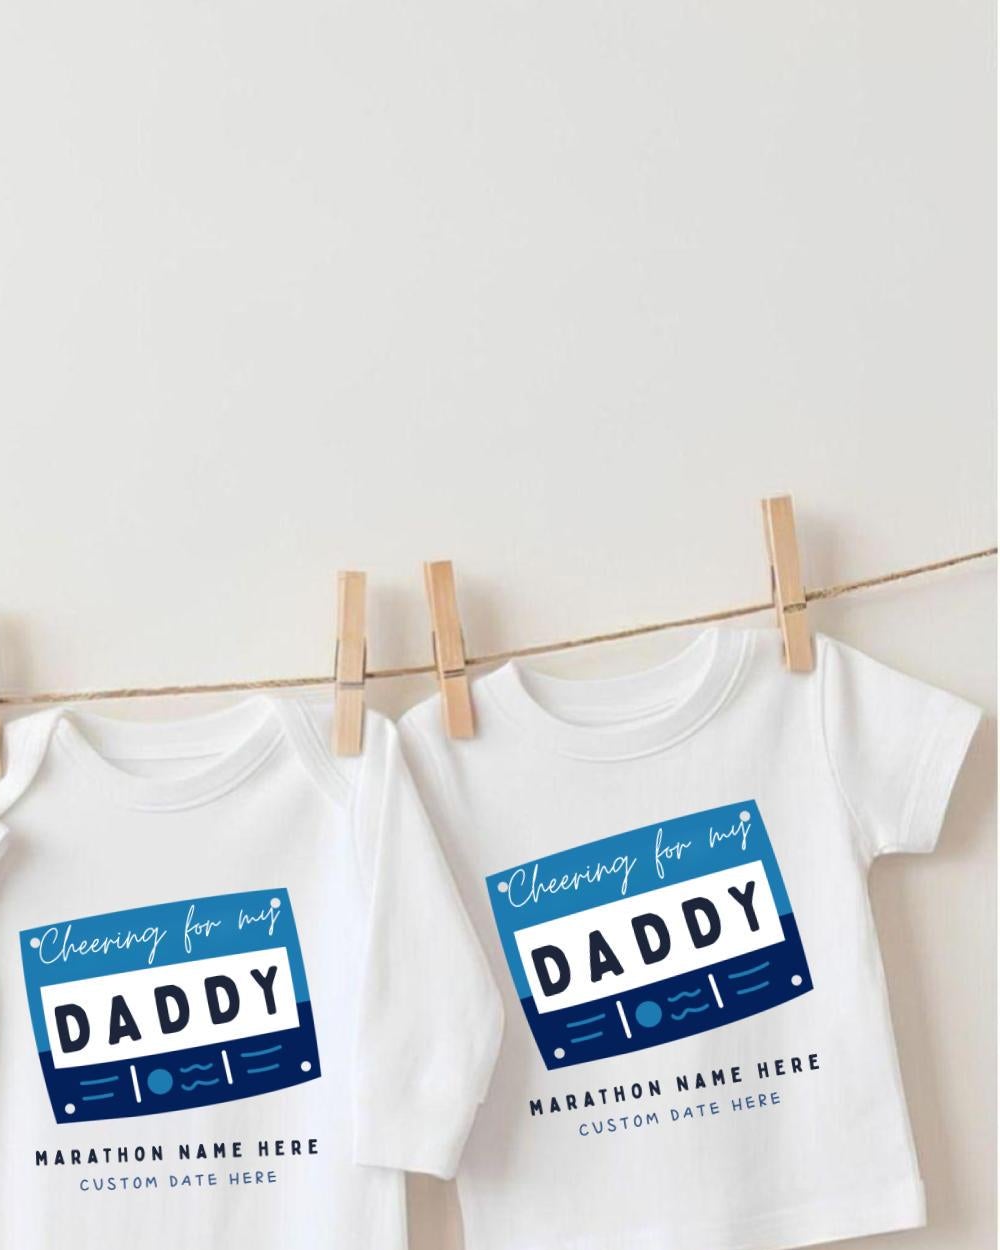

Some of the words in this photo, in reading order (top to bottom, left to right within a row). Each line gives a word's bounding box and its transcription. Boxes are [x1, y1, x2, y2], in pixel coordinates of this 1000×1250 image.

[507, 853, 637, 908] Cheering
[655, 827, 692, 879] for
[710, 819, 751, 850] my
[38, 923, 167, 965] Cheering
[185, 905, 220, 952] for
[239, 906, 280, 935] my
[531, 880, 760, 997] DADDY
[54, 965, 278, 1054] DADDY
[529, 1080, 661, 1116] MARATHON
[676, 1066, 742, 1092] NAME
[757, 1054, 819, 1079] HERE
[579, 1113, 658, 1136] CUSTOM
[670, 1102, 720, 1121] DATE
[731, 1092, 780, 1111] HERE
[36, 1145, 163, 1166] MARATHON
[179, 1142, 242, 1160] NAME
[258, 1139, 318, 1157] HERE
[80, 1177, 157, 1191] CUSTOM
[170, 1173, 217, 1187] DATE
[229, 1171, 276, 1184] HERE
